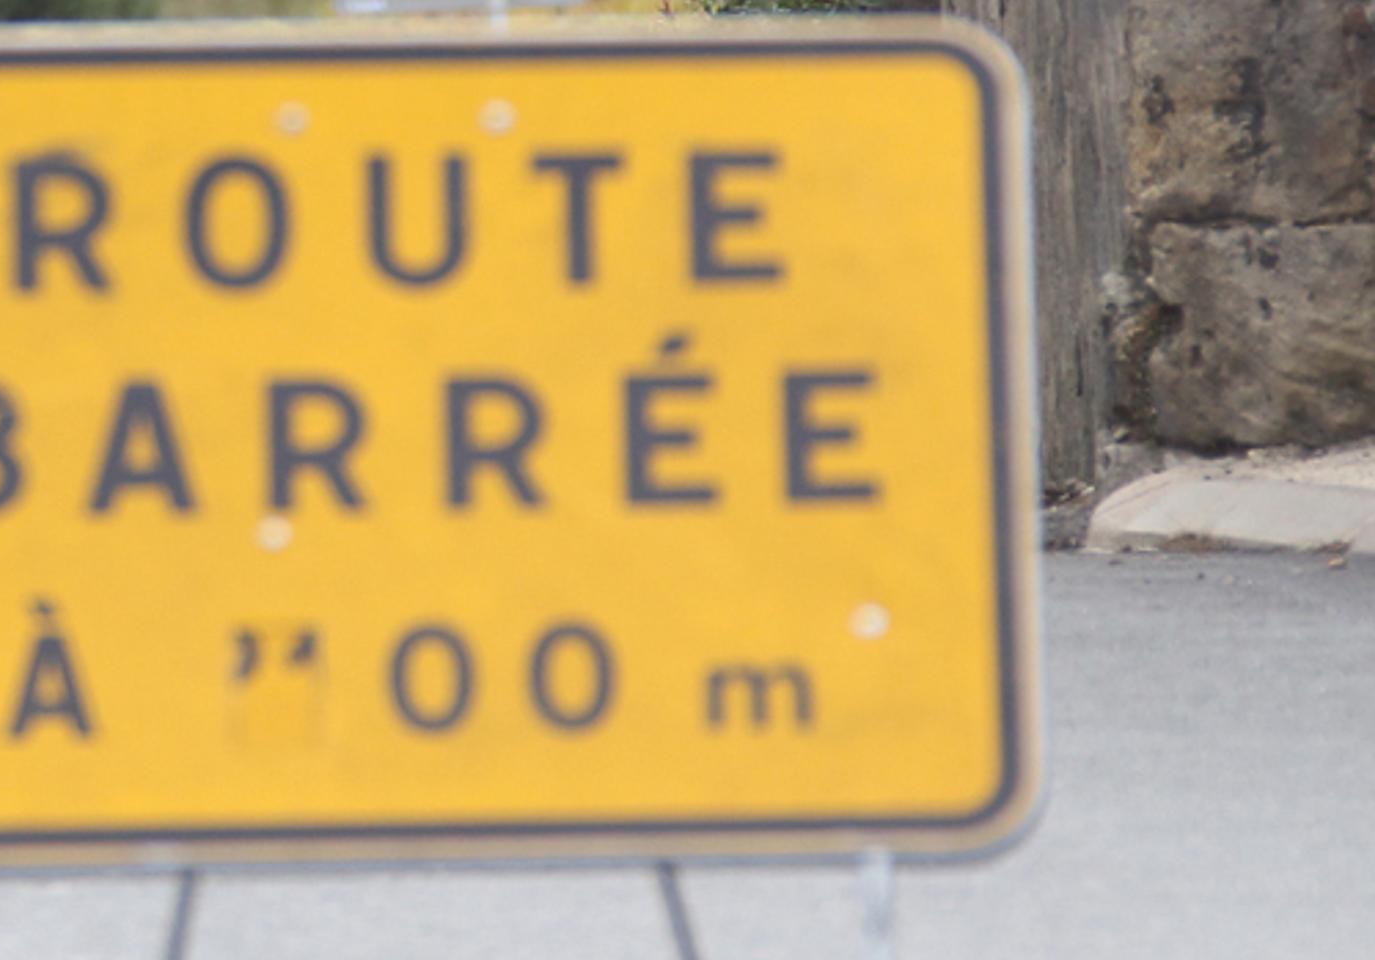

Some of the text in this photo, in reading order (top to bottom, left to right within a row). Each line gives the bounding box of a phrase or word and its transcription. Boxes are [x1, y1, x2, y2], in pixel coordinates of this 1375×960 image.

[6, 146, 788, 296] ROUTE
[7, 592, 814, 740] À 00 m
